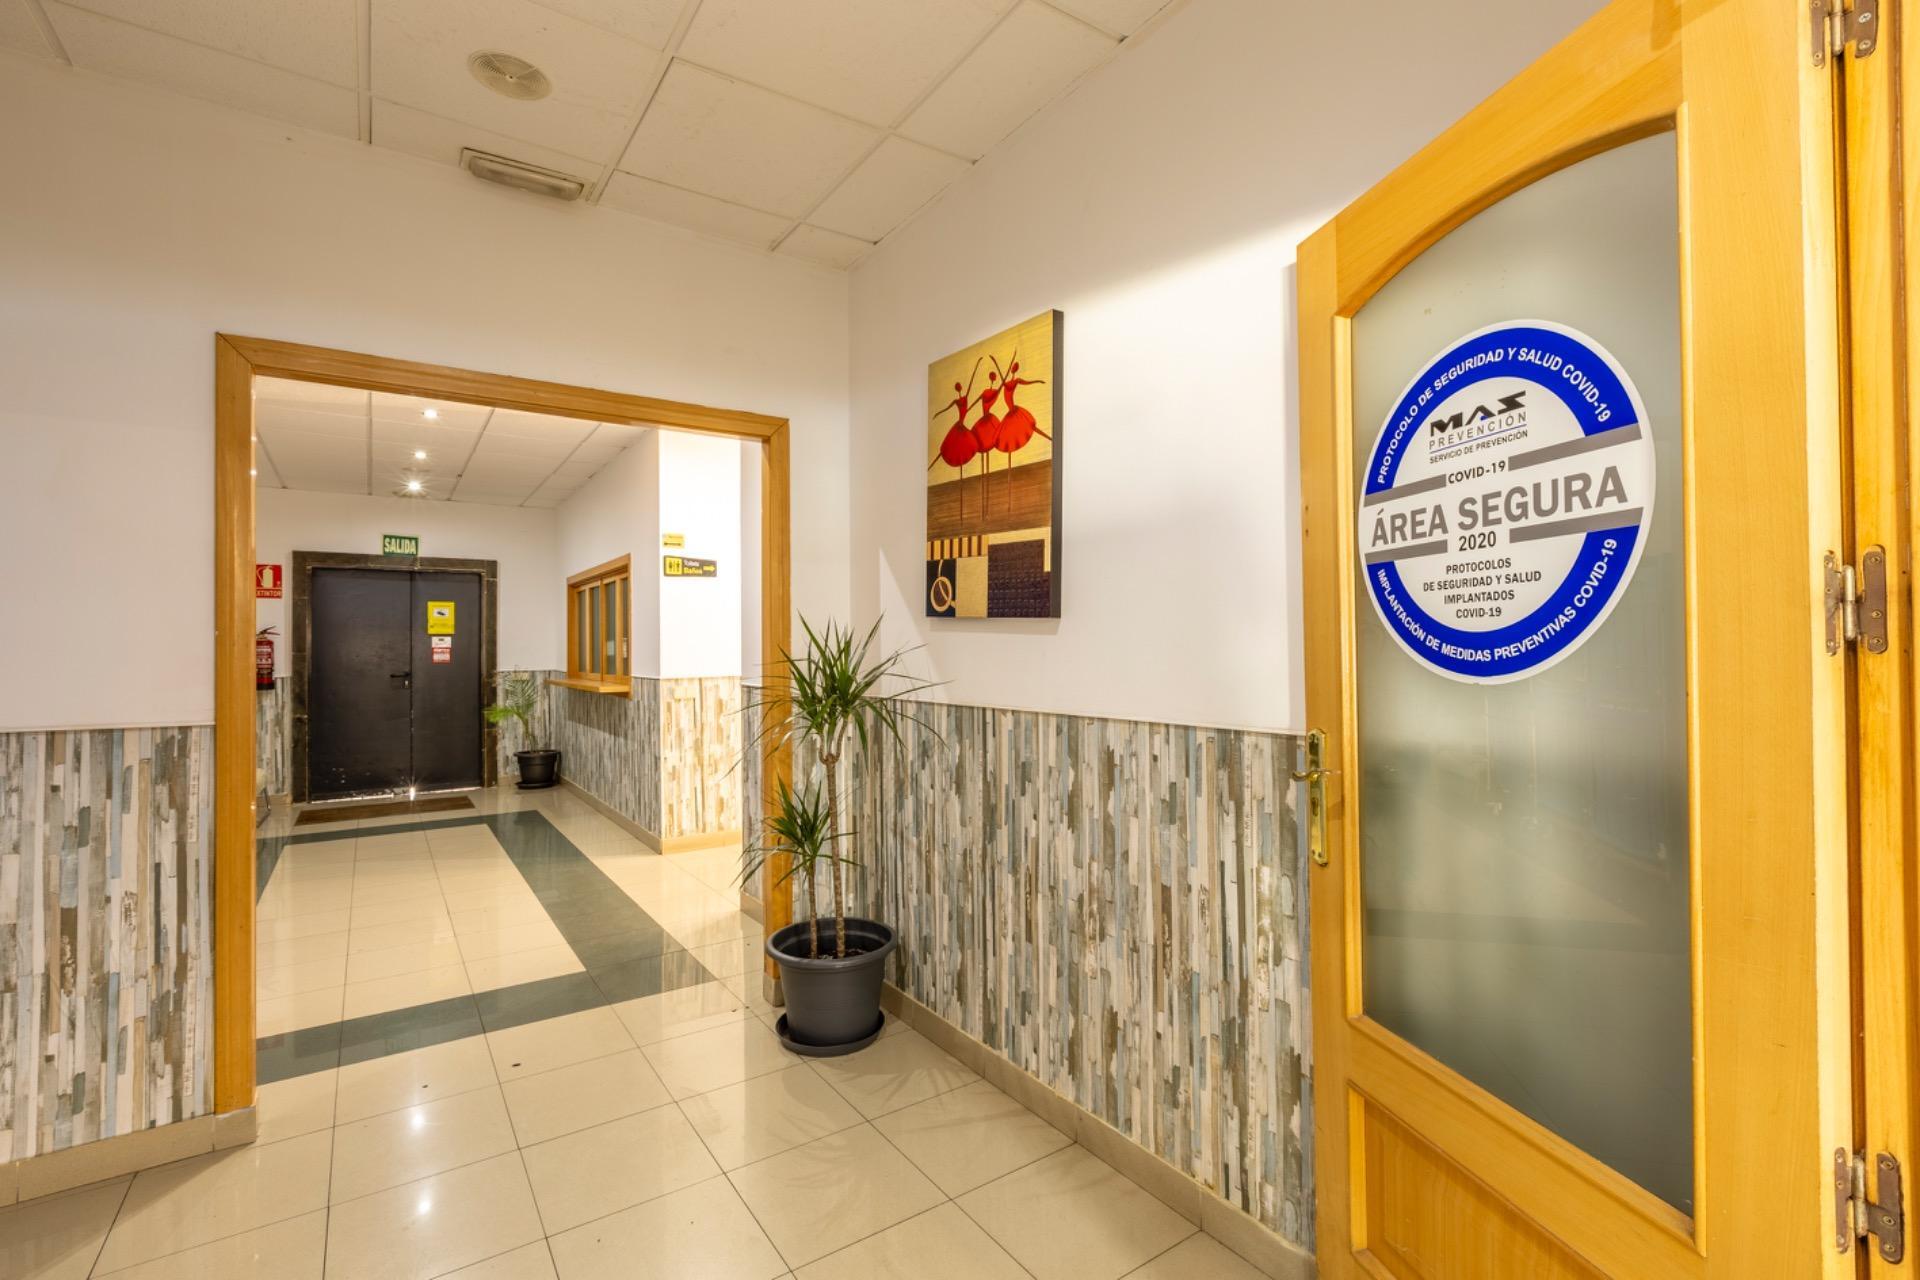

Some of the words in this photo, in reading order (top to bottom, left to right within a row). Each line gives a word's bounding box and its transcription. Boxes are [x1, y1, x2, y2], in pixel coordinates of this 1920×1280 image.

[1377, 404, 1419, 484] PROTOCOLO
[1418, 386, 1434, 407] DE
[1433, 348, 1504, 391] SEGURIDAD
[1507, 347, 1517, 361] Y
[1517, 347, 1563, 372] SALUD
[1562, 363, 1612, 424] COVID-19
[1429, 410, 1528, 450] PREVENCIÓN
[1429, 449, 1463, 464] SERVICIO
[1463, 446, 1475, 457] DE
[1475, 429, 1529, 452] PREVENCIÓN
[1448, 460, 1507, 484] COVID-19
[1371, 503, 1449, 548] ÁREA
[1457, 465, 1629, 531] SEGURA
[384, 537, 417, 554] SALIDA
[1458, 530, 1497, 551] 2020
[1446, 557, 1512, 575] PROTOCOLOS
[1423, 582, 1435, 592] DE
[1436, 576, 1494, 591] SEGURIDAD
[1495, 574, 1503, 584] Y
[1504, 570, 1542, 585] SALUD
[1377, 568, 1426, 643] IMPLANTACIÓN
[1425, 635, 1440, 651] DE
[1440, 642, 1492, 662] MEDIDAS
[1494, 607, 1577, 660] PREVENTIVAS
[1573, 538, 1618, 608] COVID-19
[1444, 590, 1515, 605] IMPLANTADOS
[1456, 607, 1502, 619] COVID-19
